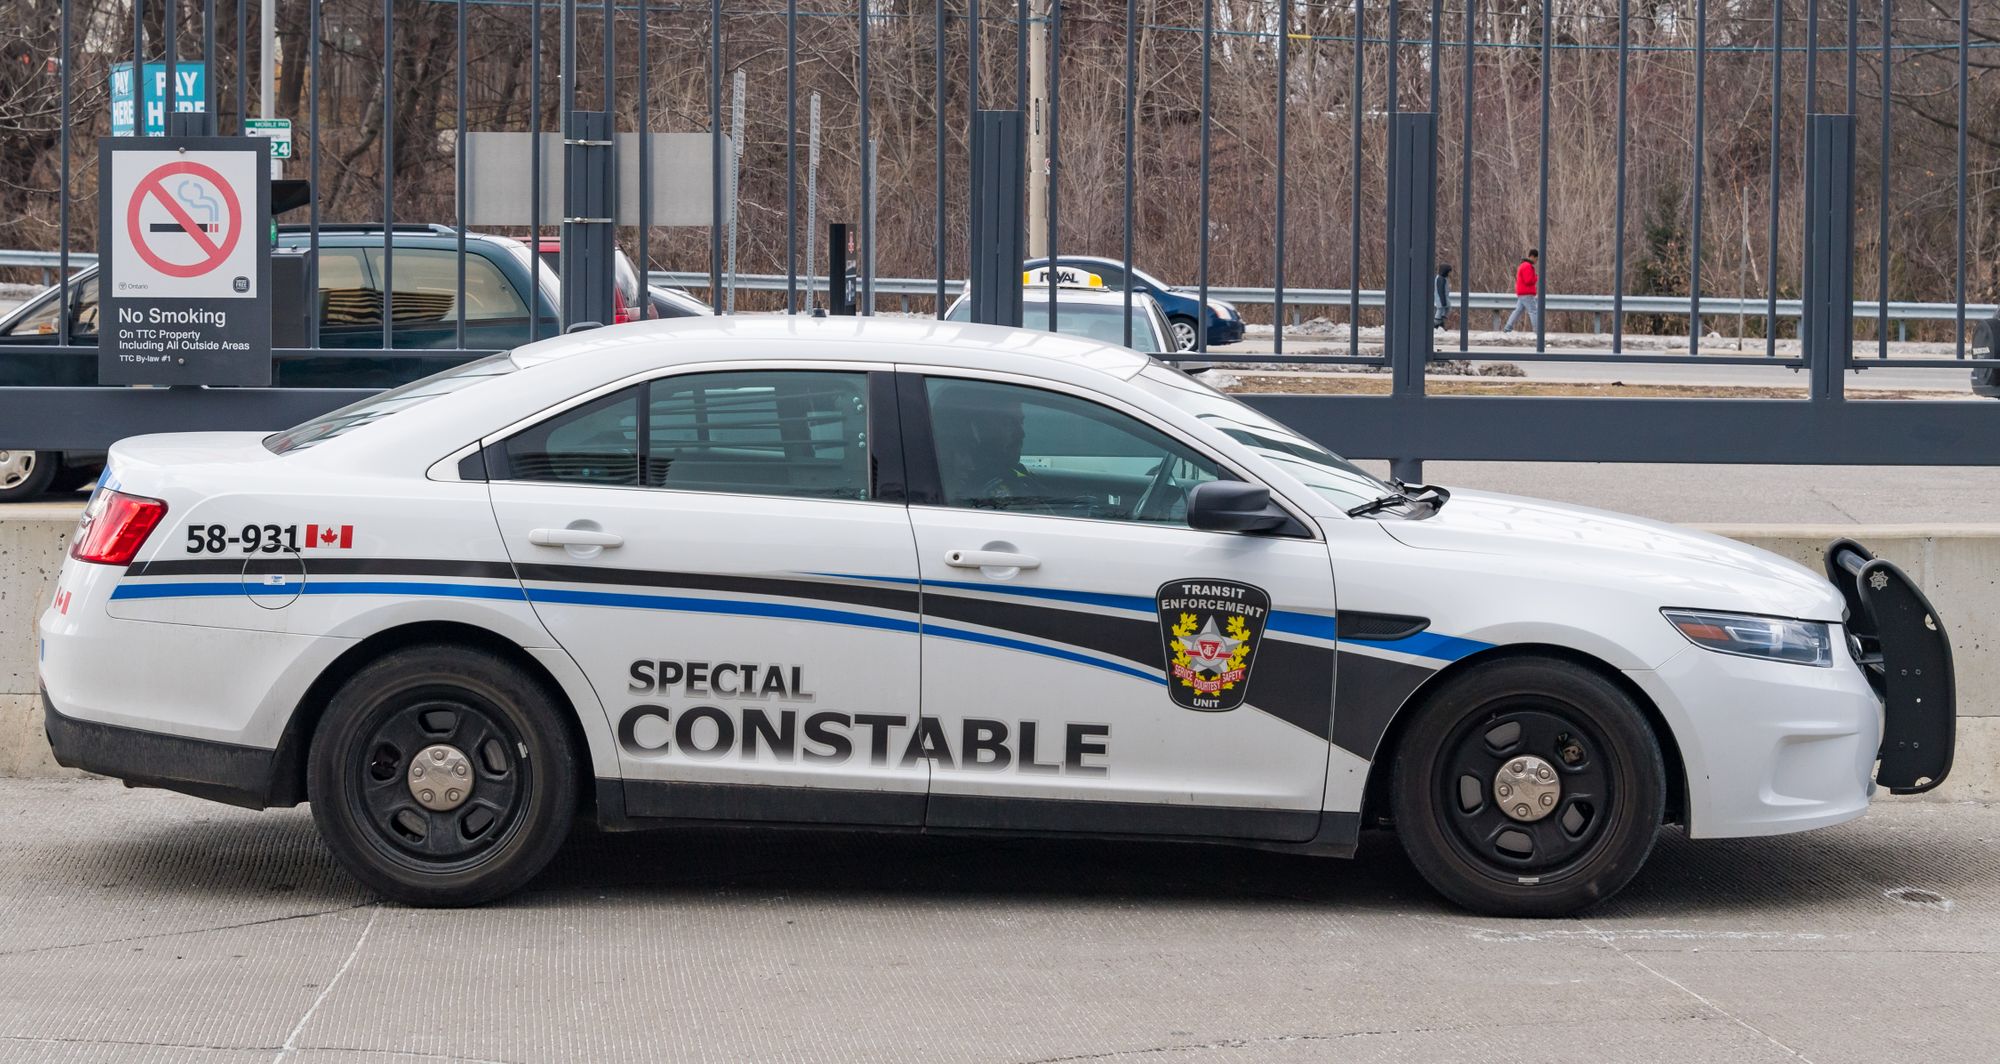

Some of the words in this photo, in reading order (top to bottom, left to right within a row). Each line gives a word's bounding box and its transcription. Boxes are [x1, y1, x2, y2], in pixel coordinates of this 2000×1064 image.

[156, 72, 198, 97] PAY
[113, 101, 134, 126] HERE
[1040, 271, 1079, 284] rYAL
[119, 307, 143, 323] No
[149, 307, 226, 328] Smoking
[119, 329, 134, 339] On
[136, 329, 157, 339] TTC
[159, 329, 201, 341] Property
[119, 340, 164, 352] Including
[166, 340, 179, 350] All
[181, 340, 219, 350] Outside
[221, 340, 250, 350] Areas
[119, 354, 135, 362] TTC
[136, 354, 160, 364] By-law
[161, 354, 171, 362] #1
[185, 524, 301, 553] 58-931
[1182, 584, 1245, 599] TRANSIT
[1161, 599, 1264, 618] ENFORCEMENT
[628, 660, 815, 701] SPECIAL
[1174, 664, 1194, 681] SERVICE
[1222, 669, 1243, 683] SAFETY
[1193, 679, 1221, 692] COURTESY
[1193, 698, 1220, 708] UNIT
[617, 704, 1111, 777] CONSTABLE
